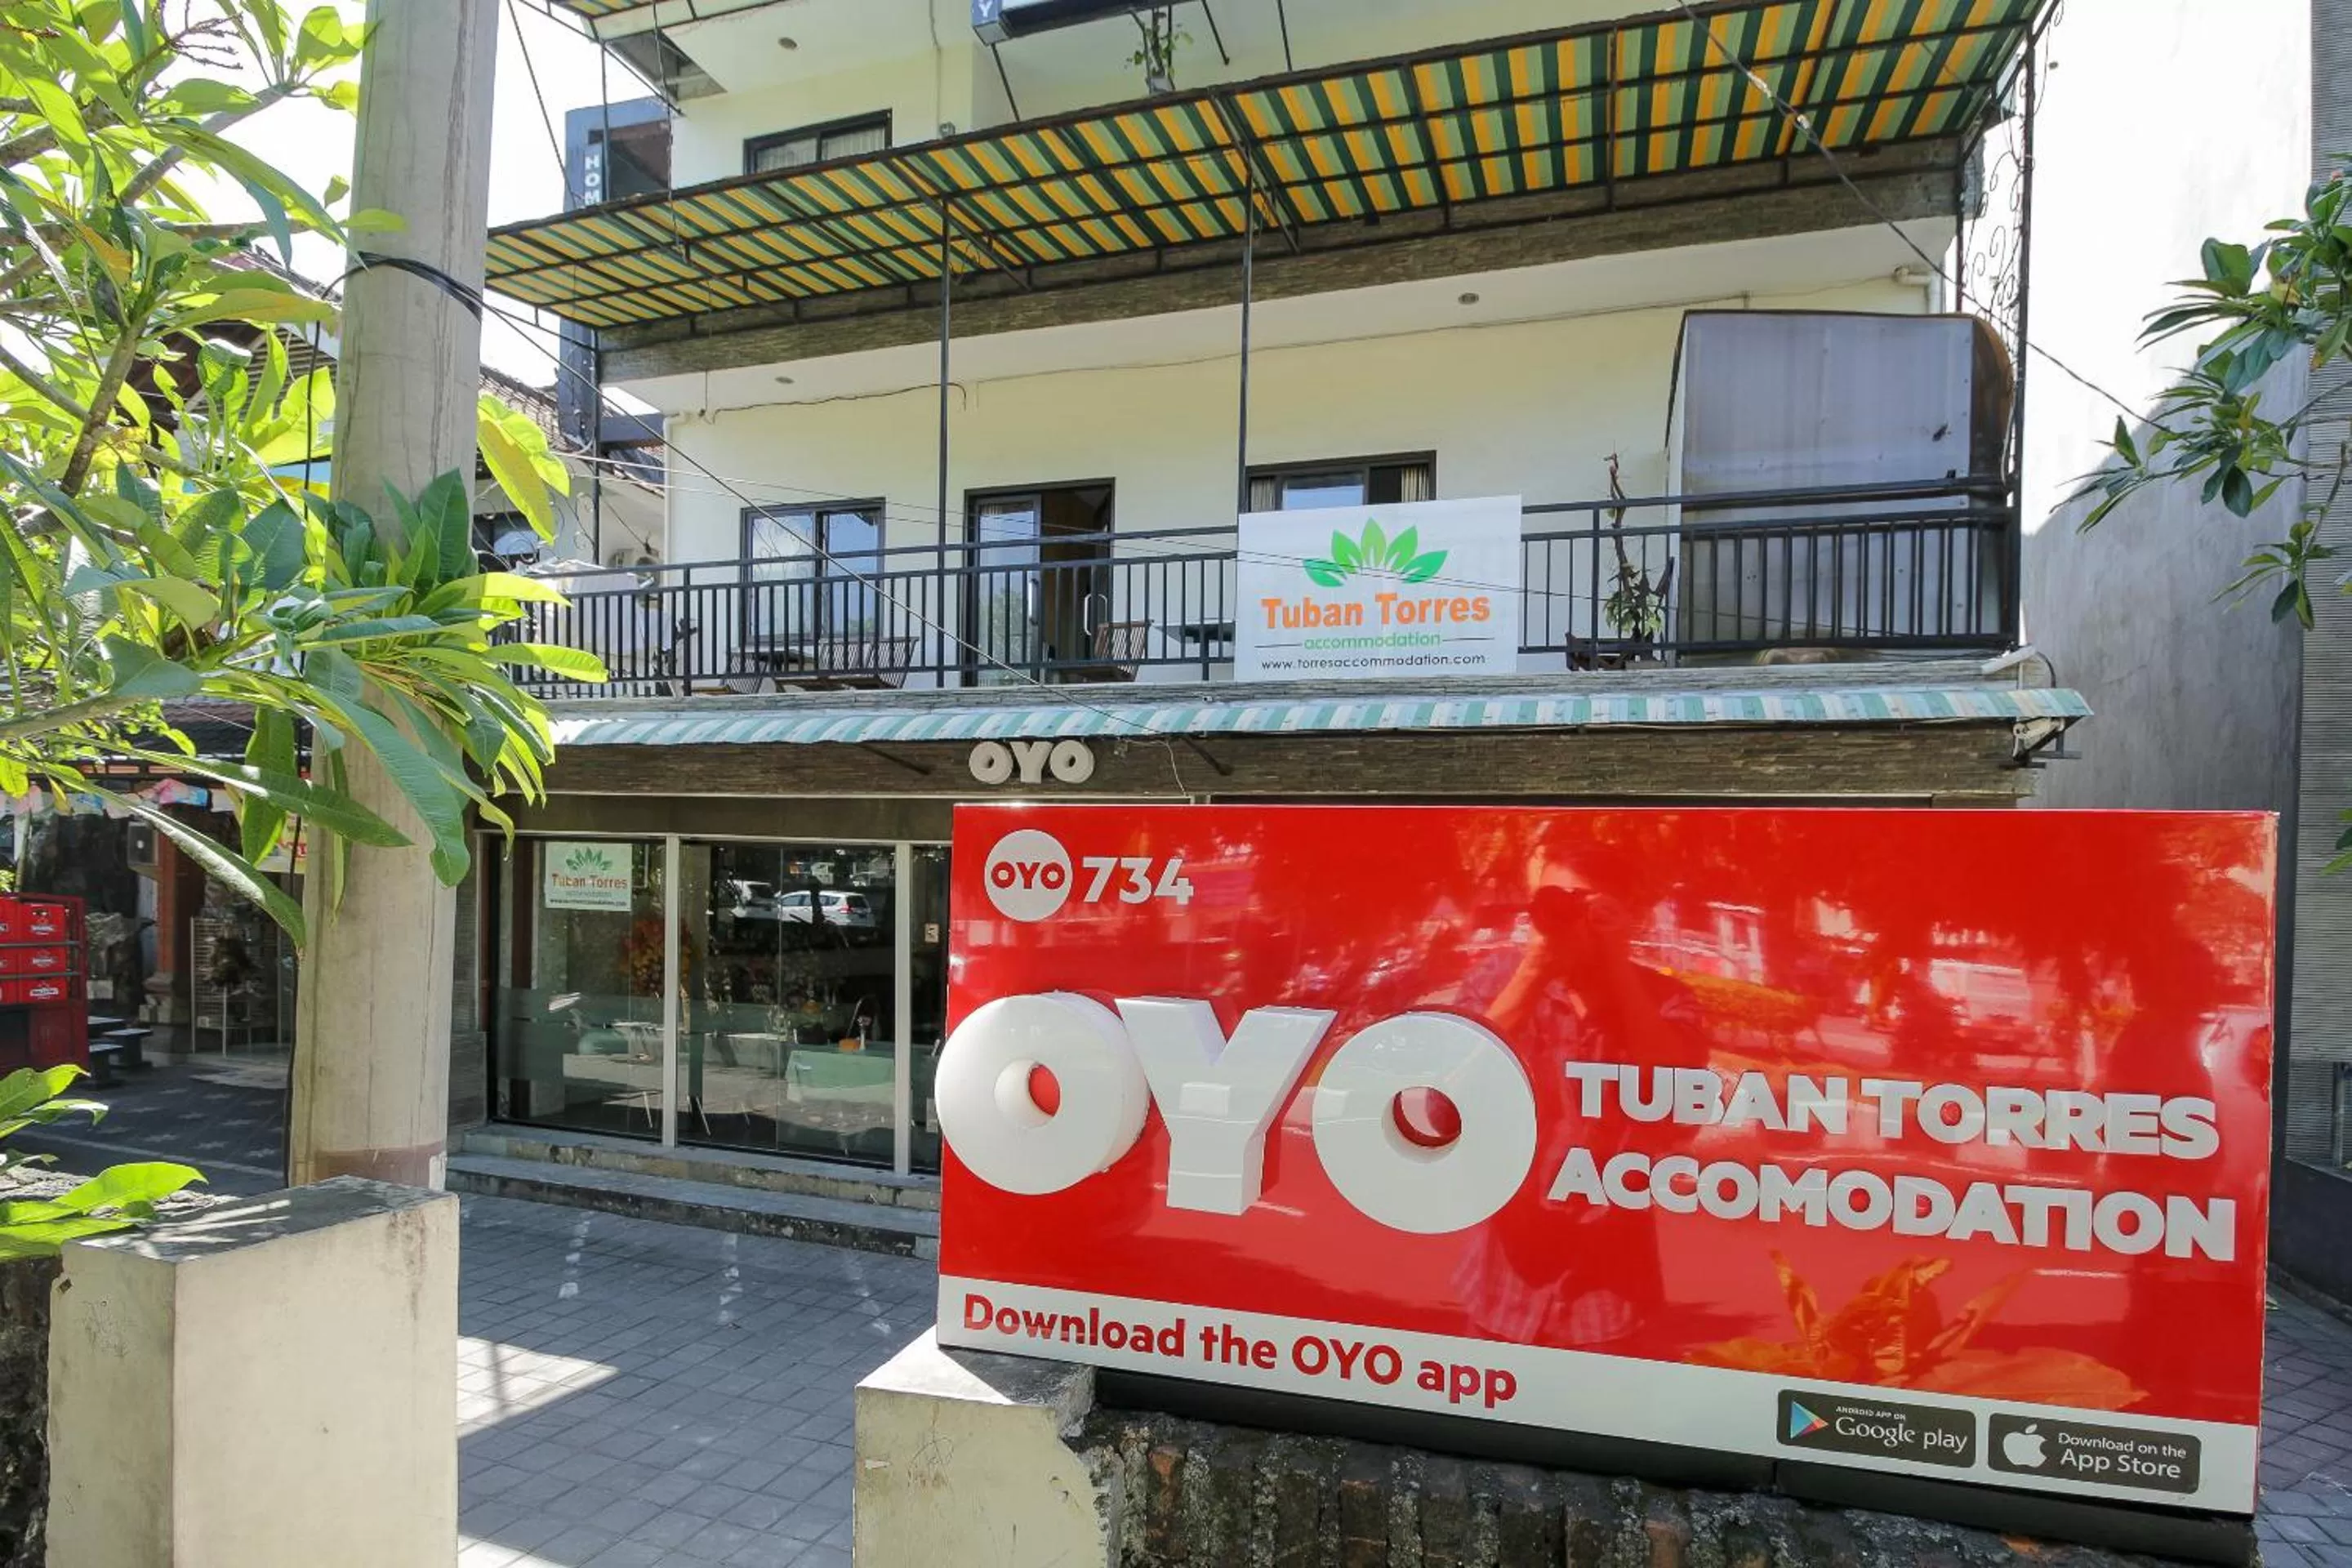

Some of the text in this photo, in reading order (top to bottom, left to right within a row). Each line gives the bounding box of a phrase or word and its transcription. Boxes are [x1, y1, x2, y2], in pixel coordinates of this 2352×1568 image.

[1261, 592, 1491, 629] Tuban Torres
[1304, 631, 1441, 651] accommodation
[1262, 654, 1486, 670] www.torresaccommodation.com
[969, 740, 1094, 784] OYO
[551, 872, 627, 889] Tuban Torres
[991, 857, 1194, 905] OYO 734
[935, 991, 1537, 1233] OYO
[1565, 1062, 2219, 1160] TUBAN TORRES
[1548, 1147, 2236, 1261] ACCOMODATION
[964, 1293, 1517, 1408] Download the OYO app
[1836, 1405, 1874, 1417] ANDROID
[1875, 1410, 1892, 1419] APP
[1835, 1416, 1967, 1454] Google play
[2058, 1432, 2187, 1459] Download on the
[2060, 1448, 2181, 1479] App Store
